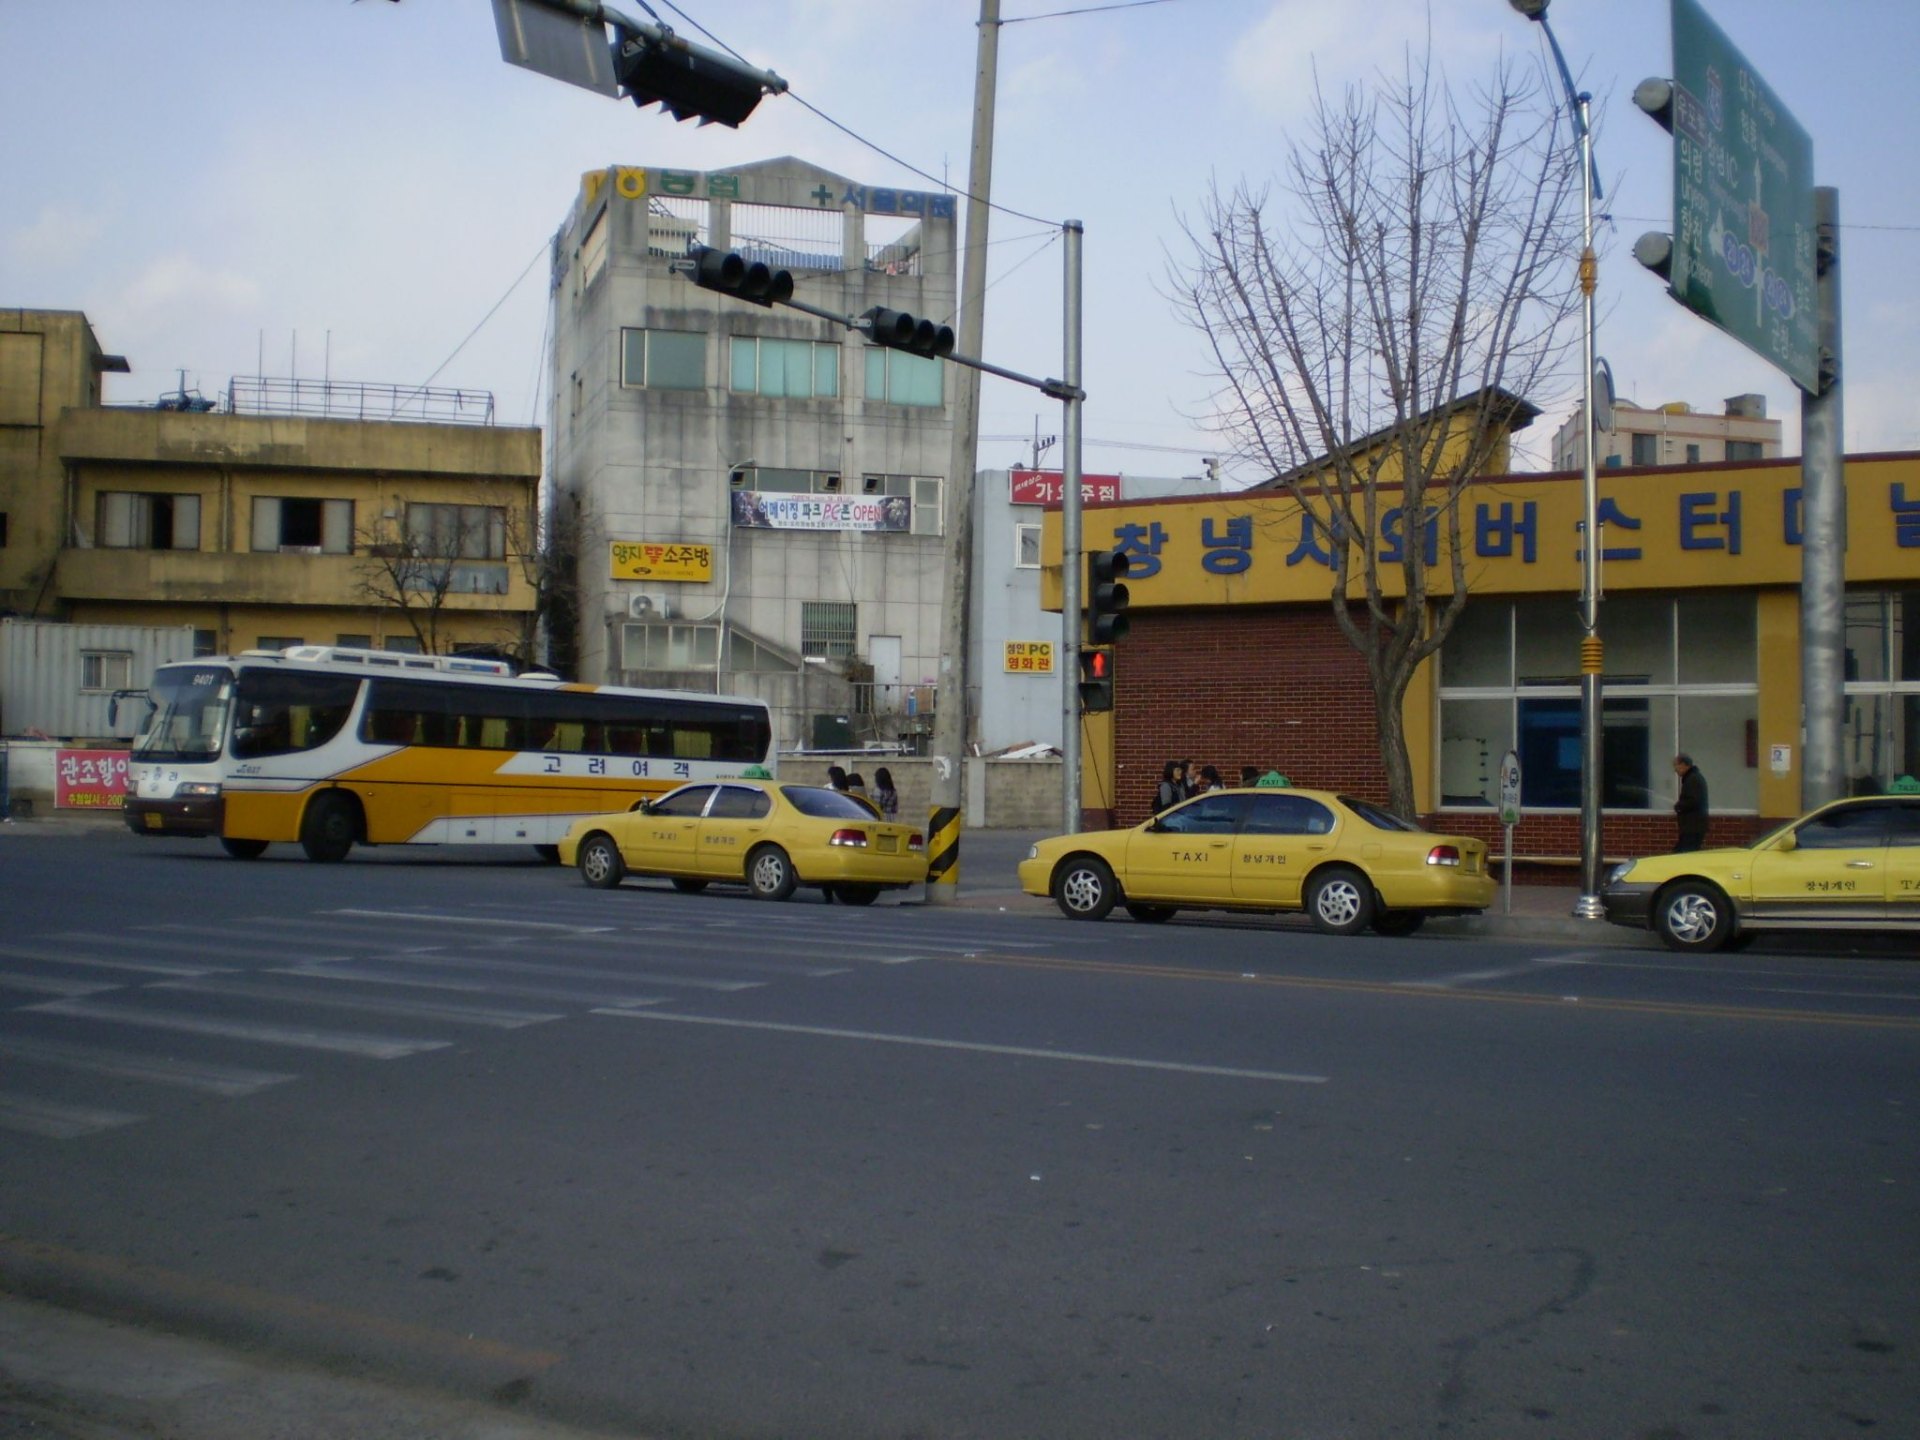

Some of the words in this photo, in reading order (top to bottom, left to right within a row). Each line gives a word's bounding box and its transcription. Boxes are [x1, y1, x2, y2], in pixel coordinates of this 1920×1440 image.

[802, 504, 821, 520] 파크
[853, 505, 883, 521] OPEN
[1029, 643, 1050, 656] PC
[543, 756, 690, 778] 고려여객
[652, 832, 677, 841] TAXI
[1172, 851, 1209, 863] TAXI
[1242, 854, 1287, 865] 창녕개인
